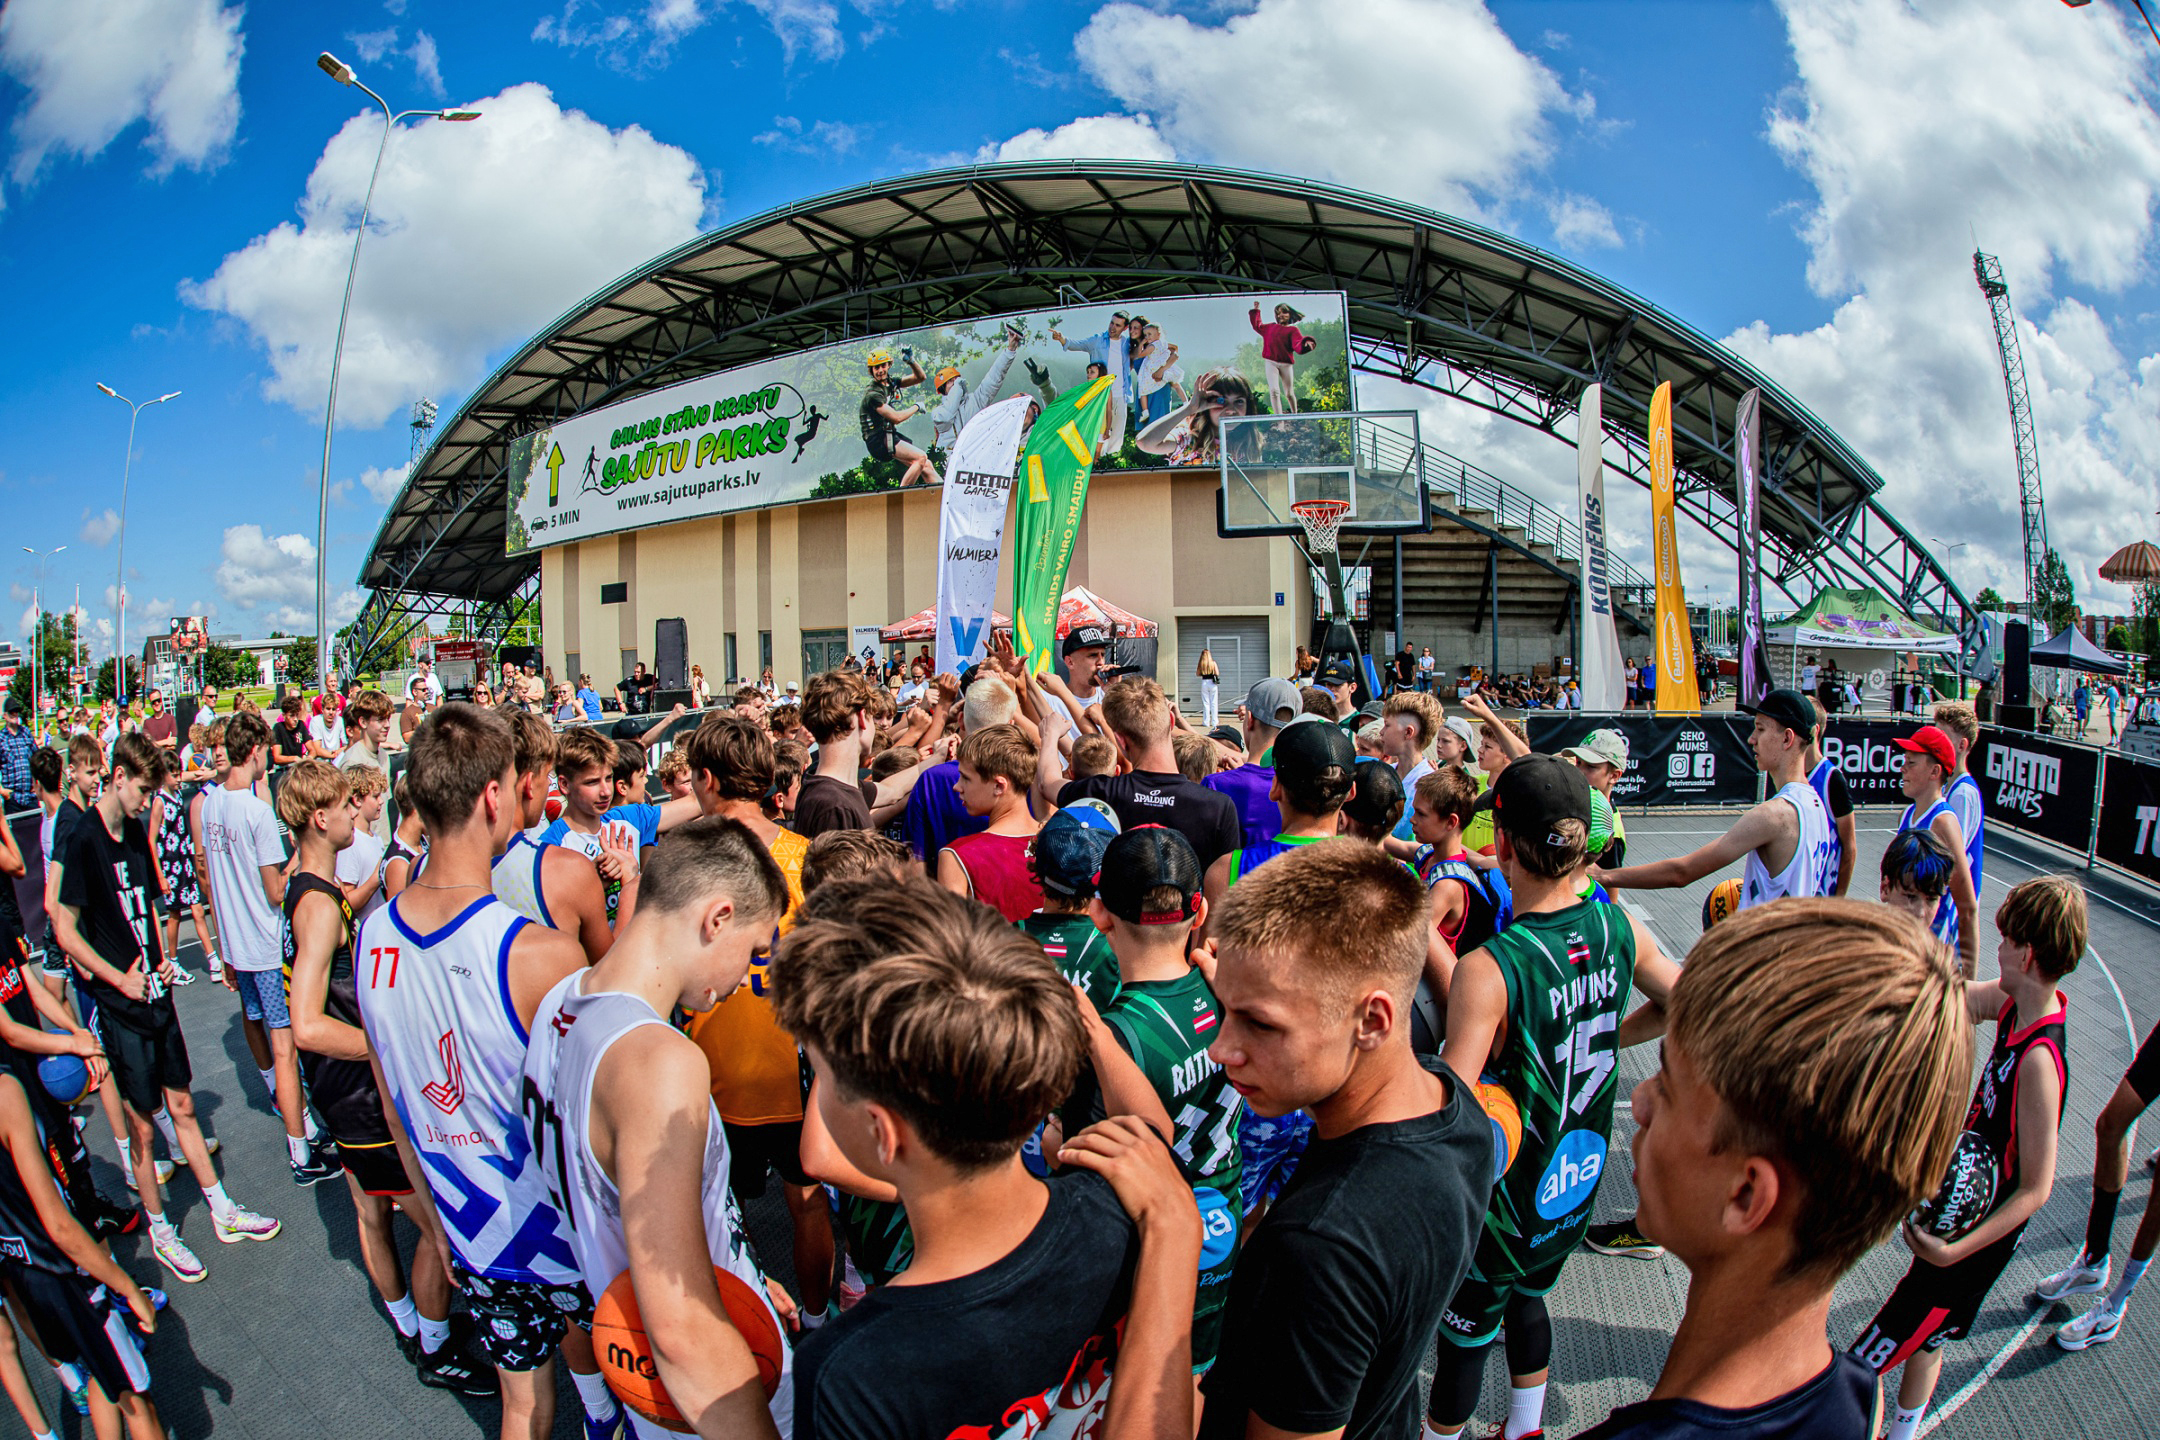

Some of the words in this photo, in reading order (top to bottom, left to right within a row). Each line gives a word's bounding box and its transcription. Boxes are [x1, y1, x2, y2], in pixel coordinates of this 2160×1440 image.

[610, 417, 661, 450] GAUJAS
[662, 406, 710, 434] STĀVO
[713, 387, 781, 421] KRASTU
[601, 439, 690, 489] SAJŪTU
[695, 417, 790, 468] PARKS
[617, 470, 761, 511] www.sajutuparks.lv
[955, 471, 1012, 489] GHETTO
[963, 486, 999, 499] GAMES
[551, 515, 557, 528] 5
[559, 509, 580, 527] MIN
[947, 544, 999, 562] VALMIERA
[1043, 574, 1061, 625] SMAIDS
[1055, 529, 1073, 571] VAIRO
[1066, 469, 1085, 526] SMAIDU
[1660, 521, 1670, 581] Balticovo
[1668, 616, 1682, 678] Balticovo
[1676, 741, 1709, 752] MUMS!
[1680, 731, 1706, 741] SEKO
[1823, 737, 1906, 773] Balcia
[1849, 778, 1905, 789] urance
[1986, 743, 2061, 796] GHETTO
[1134, 792, 1176, 807] SPALDING
[1996, 783, 2044, 818] GAMES
[370, 947, 400, 989] 17
[1554, 1009, 1618, 1131] 15
[1541, 1153, 1601, 1205] aha
[1936, 1152, 1976, 1231] SPALDING
[1854, 1323, 1898, 1369] 18
